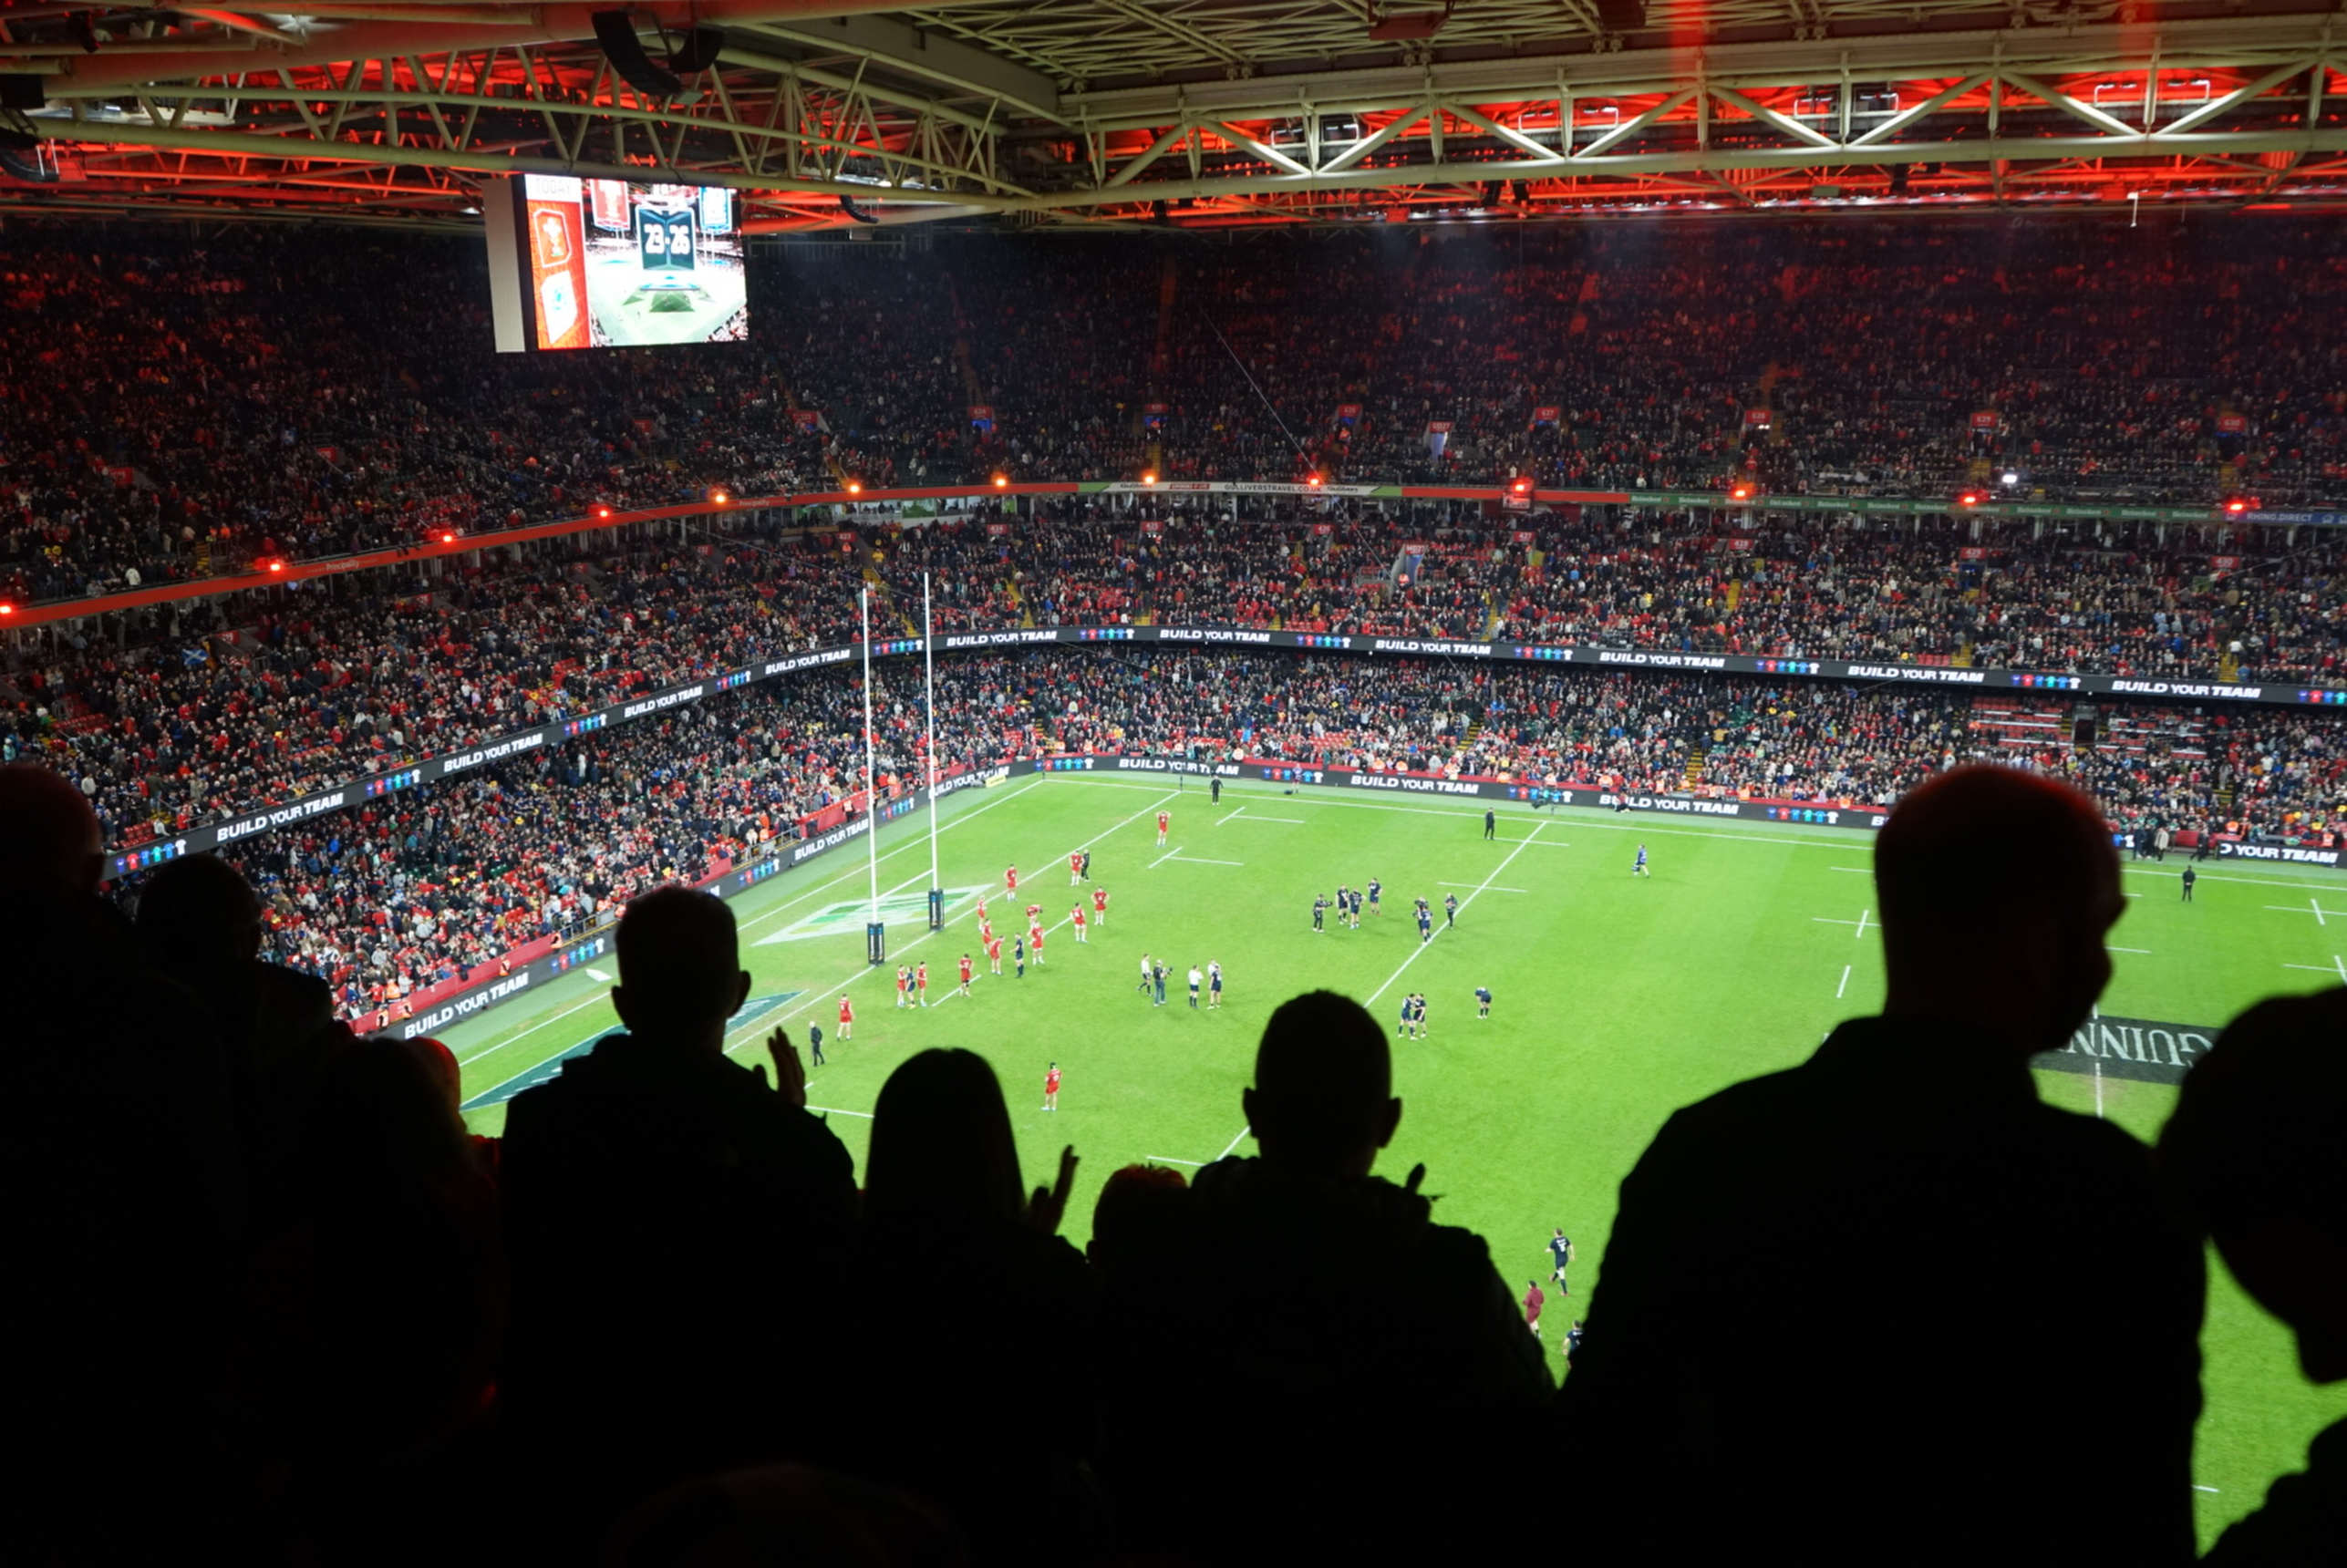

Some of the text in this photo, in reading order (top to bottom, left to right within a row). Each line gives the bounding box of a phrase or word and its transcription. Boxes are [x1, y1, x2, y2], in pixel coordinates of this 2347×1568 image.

[946, 630, 1058, 647] BUILD YOUR TEAM
[1160, 629, 1270, 643] BUILD YOUR TEAM
[1375, 639, 1492, 655] BUILD YOUR TEAM
[765, 648, 851, 676] BUILD YOUR TEAM
[1599, 651, 1725, 668] BUILD YOUR TEAM
[1847, 665, 1985, 683] BUILD YOUR TEAM
[2112, 680, 2261, 699] BUILD YOUR TEAM
[624, 685, 703, 718] BUILD YOUR TEAM
[444, 732, 543, 773] BUILD YOUR TEAM
[1119, 758, 1165, 769] BUILD
[928, 779, 953, 800] UILD
[1350, 775, 1479, 794] BUILD YOUR TEAM
[217, 791, 344, 842] BUILD YOUR TEAM
[1653, 799, 1690, 811] YOUR
[1692, 800, 1740, 815] TEAM
[794, 818, 869, 861] BUILD YOUR TEAM
[2235, 844, 2279, 860] YOUR
[2281, 848, 2339, 864] TEAM
[404, 972, 529, 1040] BUILD YOUR TEAM
[2056, 1022, 2213, 1068] GUINN
